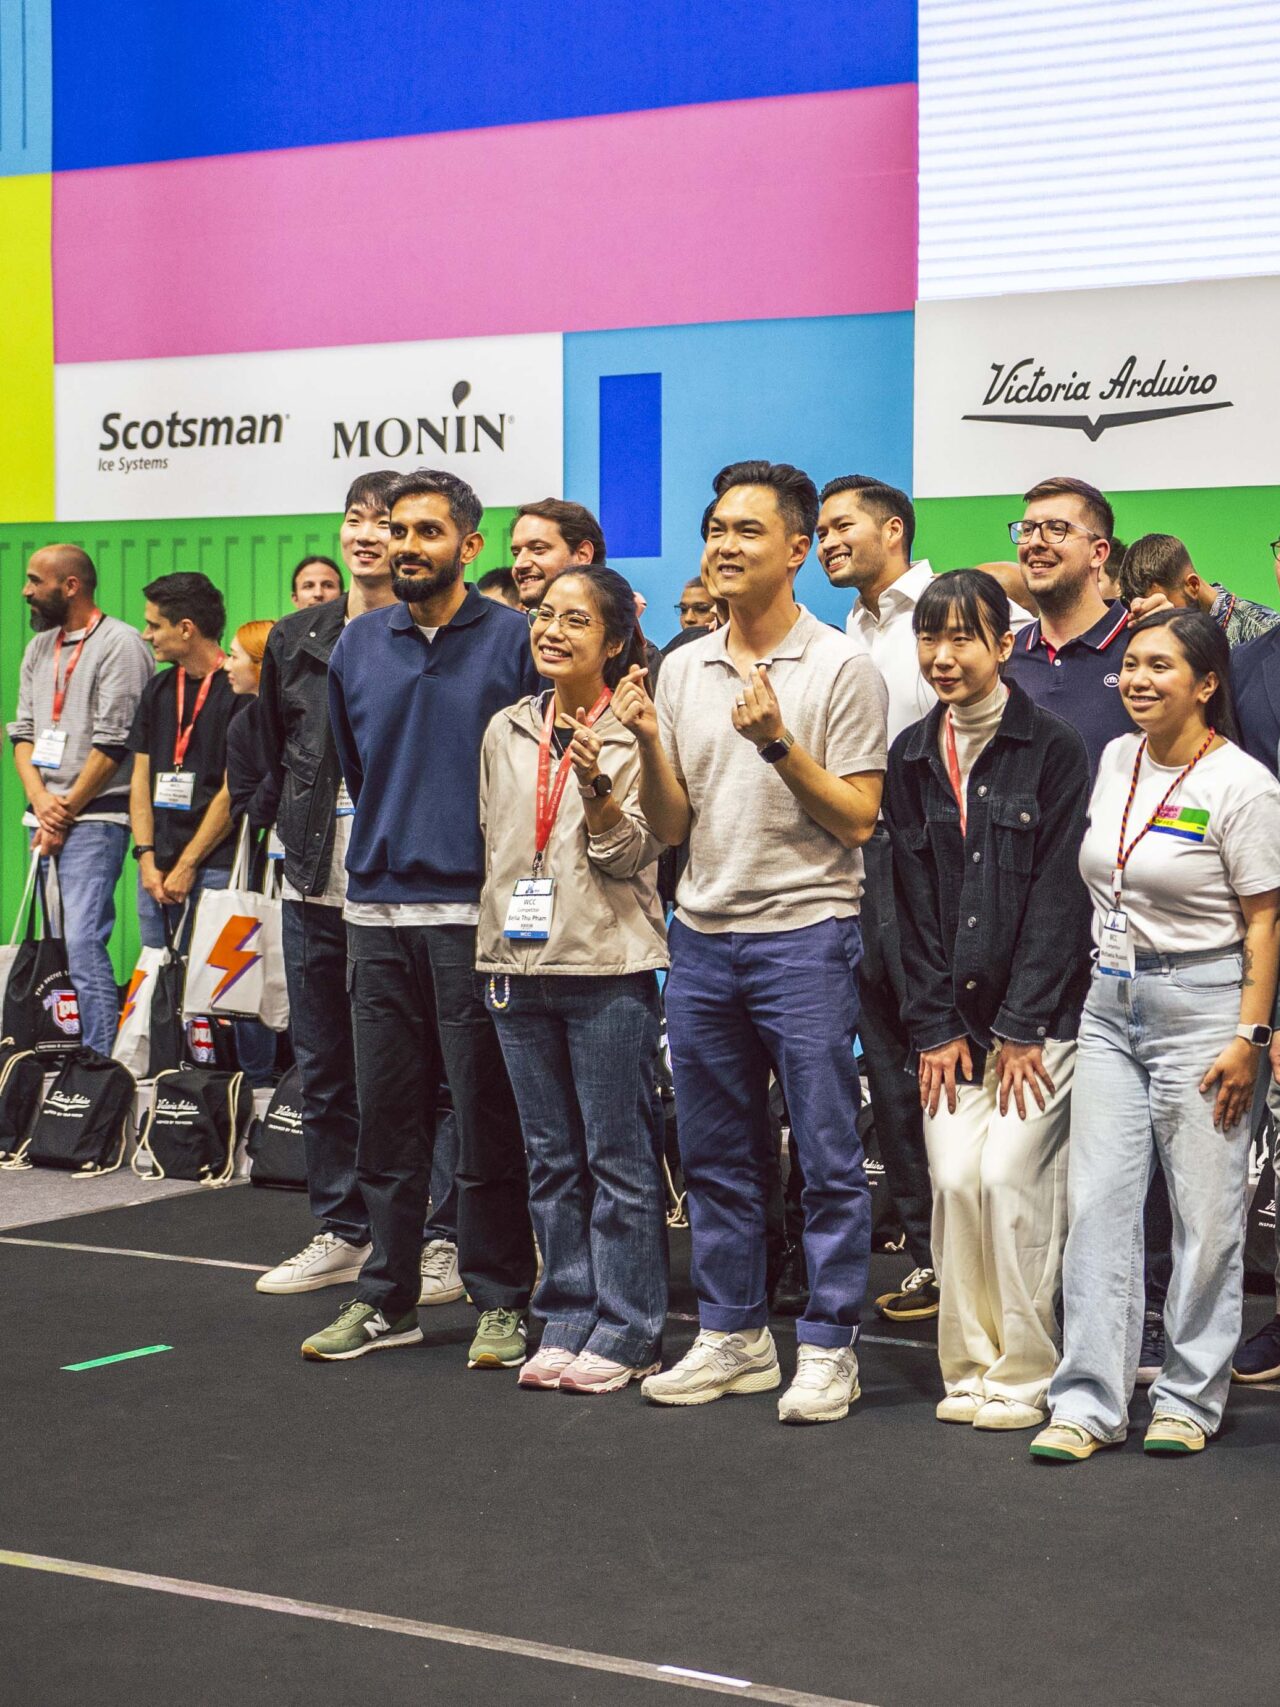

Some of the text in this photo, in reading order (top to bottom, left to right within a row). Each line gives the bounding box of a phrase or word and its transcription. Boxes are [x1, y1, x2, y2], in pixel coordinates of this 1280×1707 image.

[982, 355, 1218, 406] Victoria Arduino
[98, 410, 284, 451] Scotsman
[97, 456, 169, 475] Ice Systems
